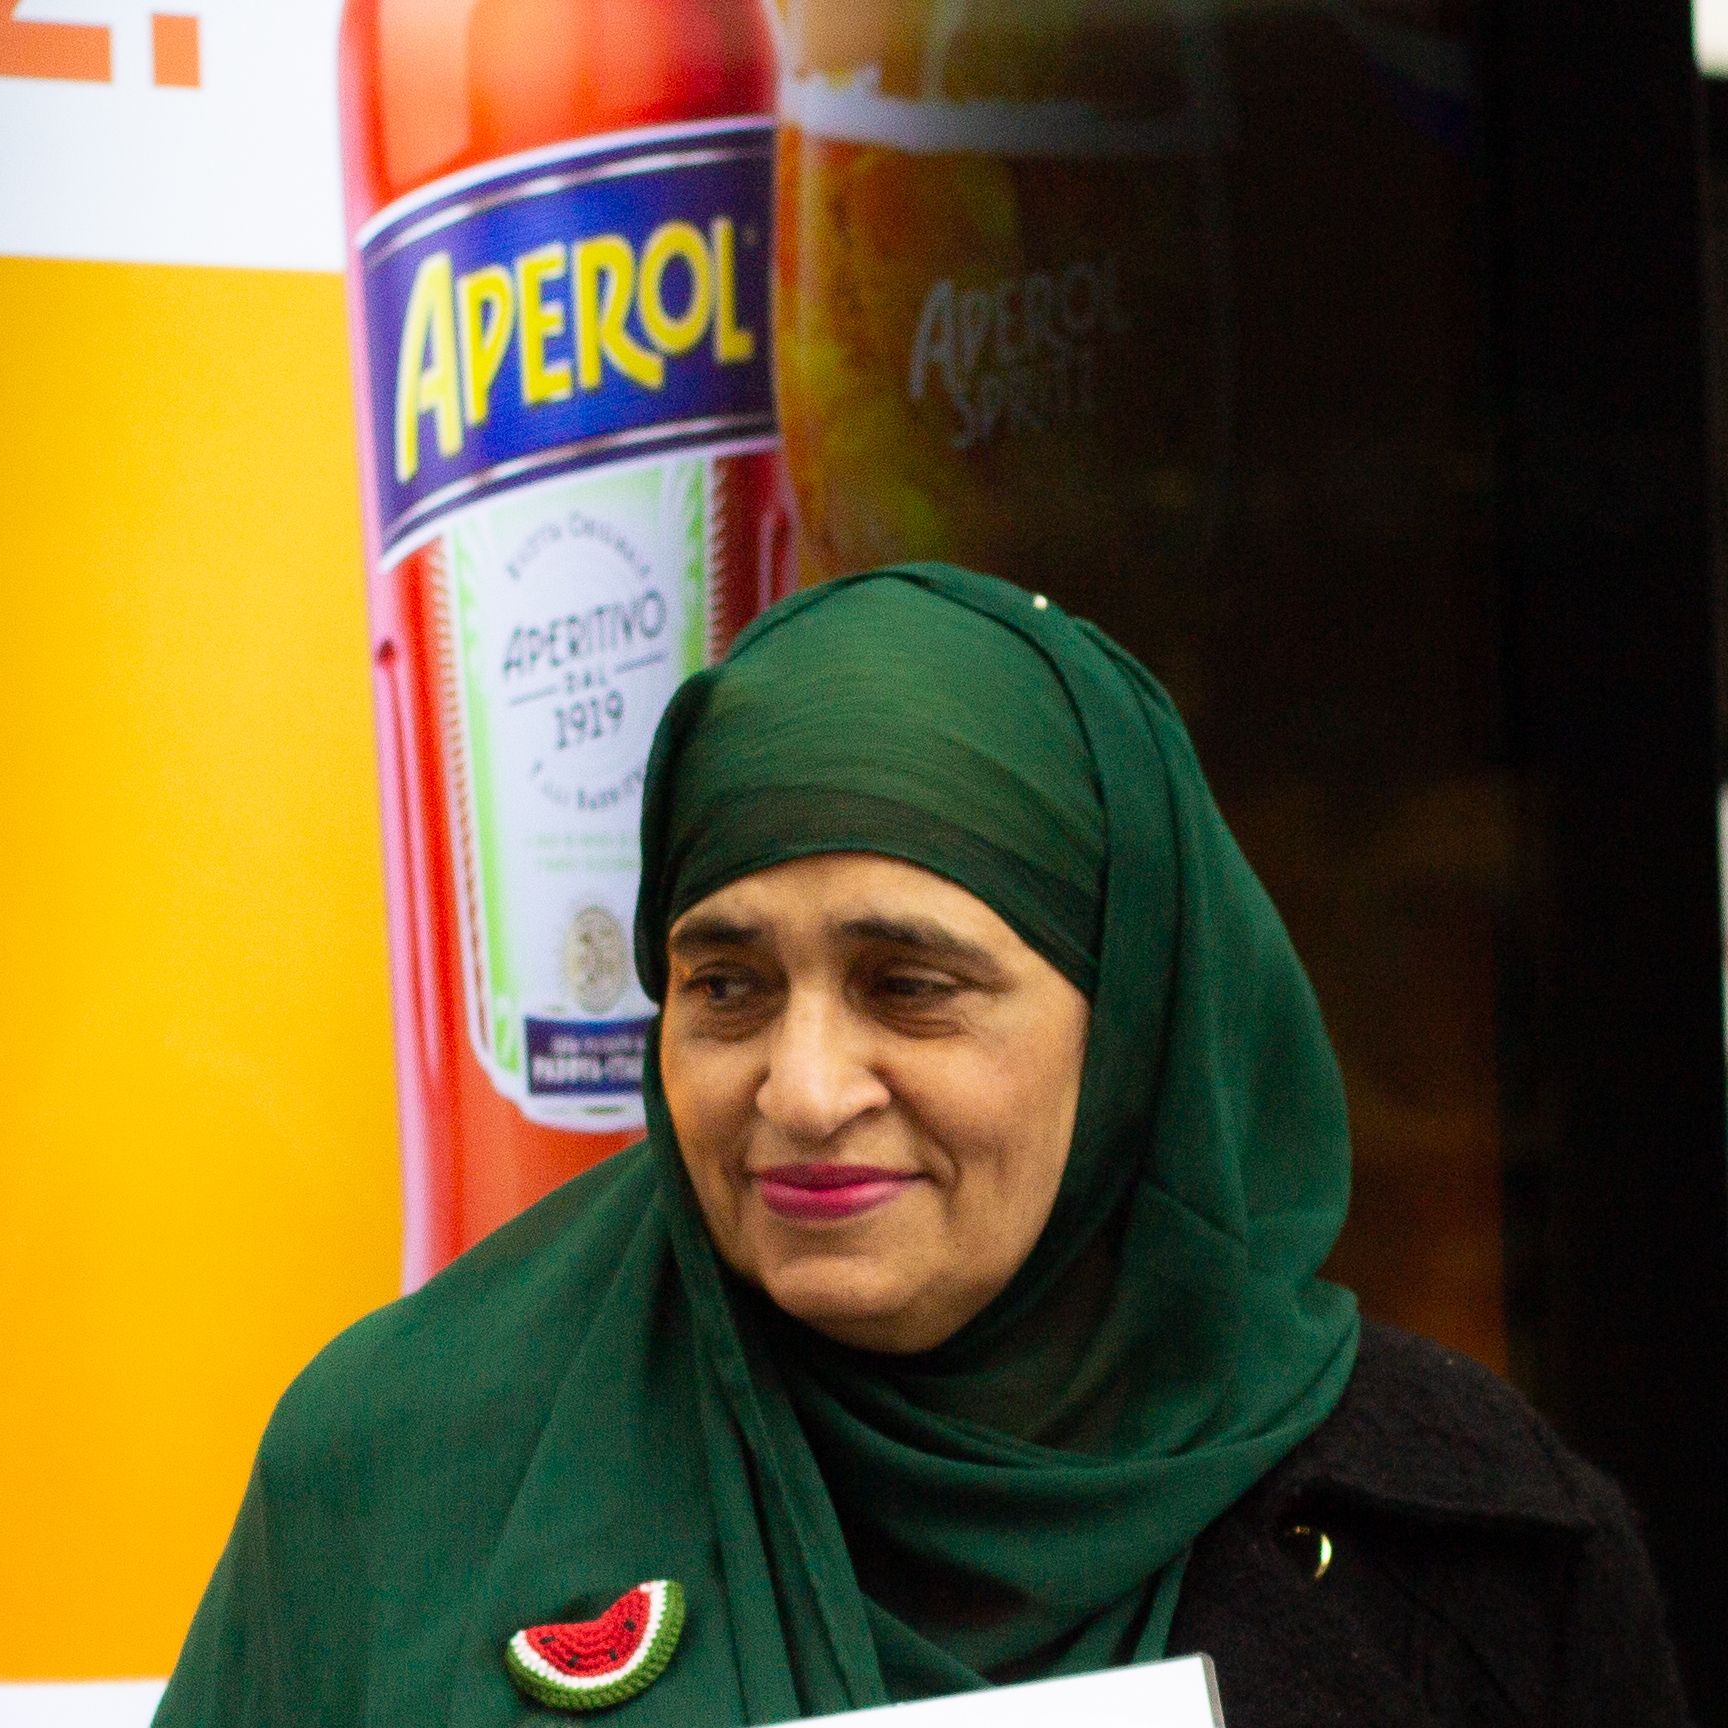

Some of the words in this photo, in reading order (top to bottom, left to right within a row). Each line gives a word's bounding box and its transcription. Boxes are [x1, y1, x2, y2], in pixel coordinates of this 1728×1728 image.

[396, 217, 755, 483] APEROL
[502, 588, 667, 680] APERITIVO
[553, 690, 625, 750] 1919
